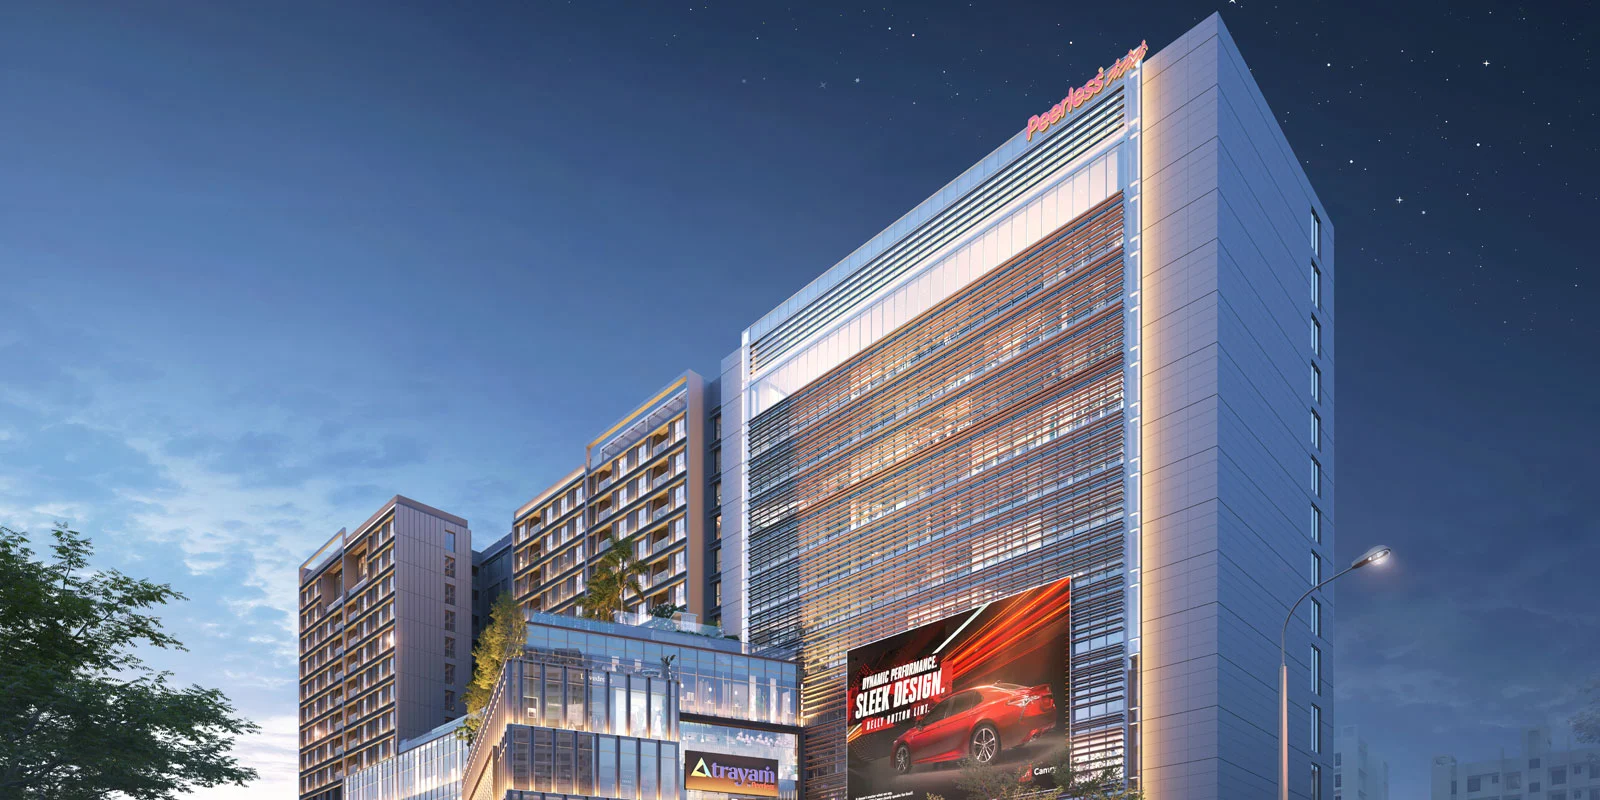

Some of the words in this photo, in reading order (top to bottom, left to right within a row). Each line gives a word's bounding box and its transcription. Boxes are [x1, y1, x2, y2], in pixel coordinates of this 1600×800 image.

[855, 683, 892, 719] SLEEK
[893, 667, 946, 708] DESIGN.
[861, 670, 890, 691] DYNAMIC
[890, 655, 938, 682] PERFORMANCE.
